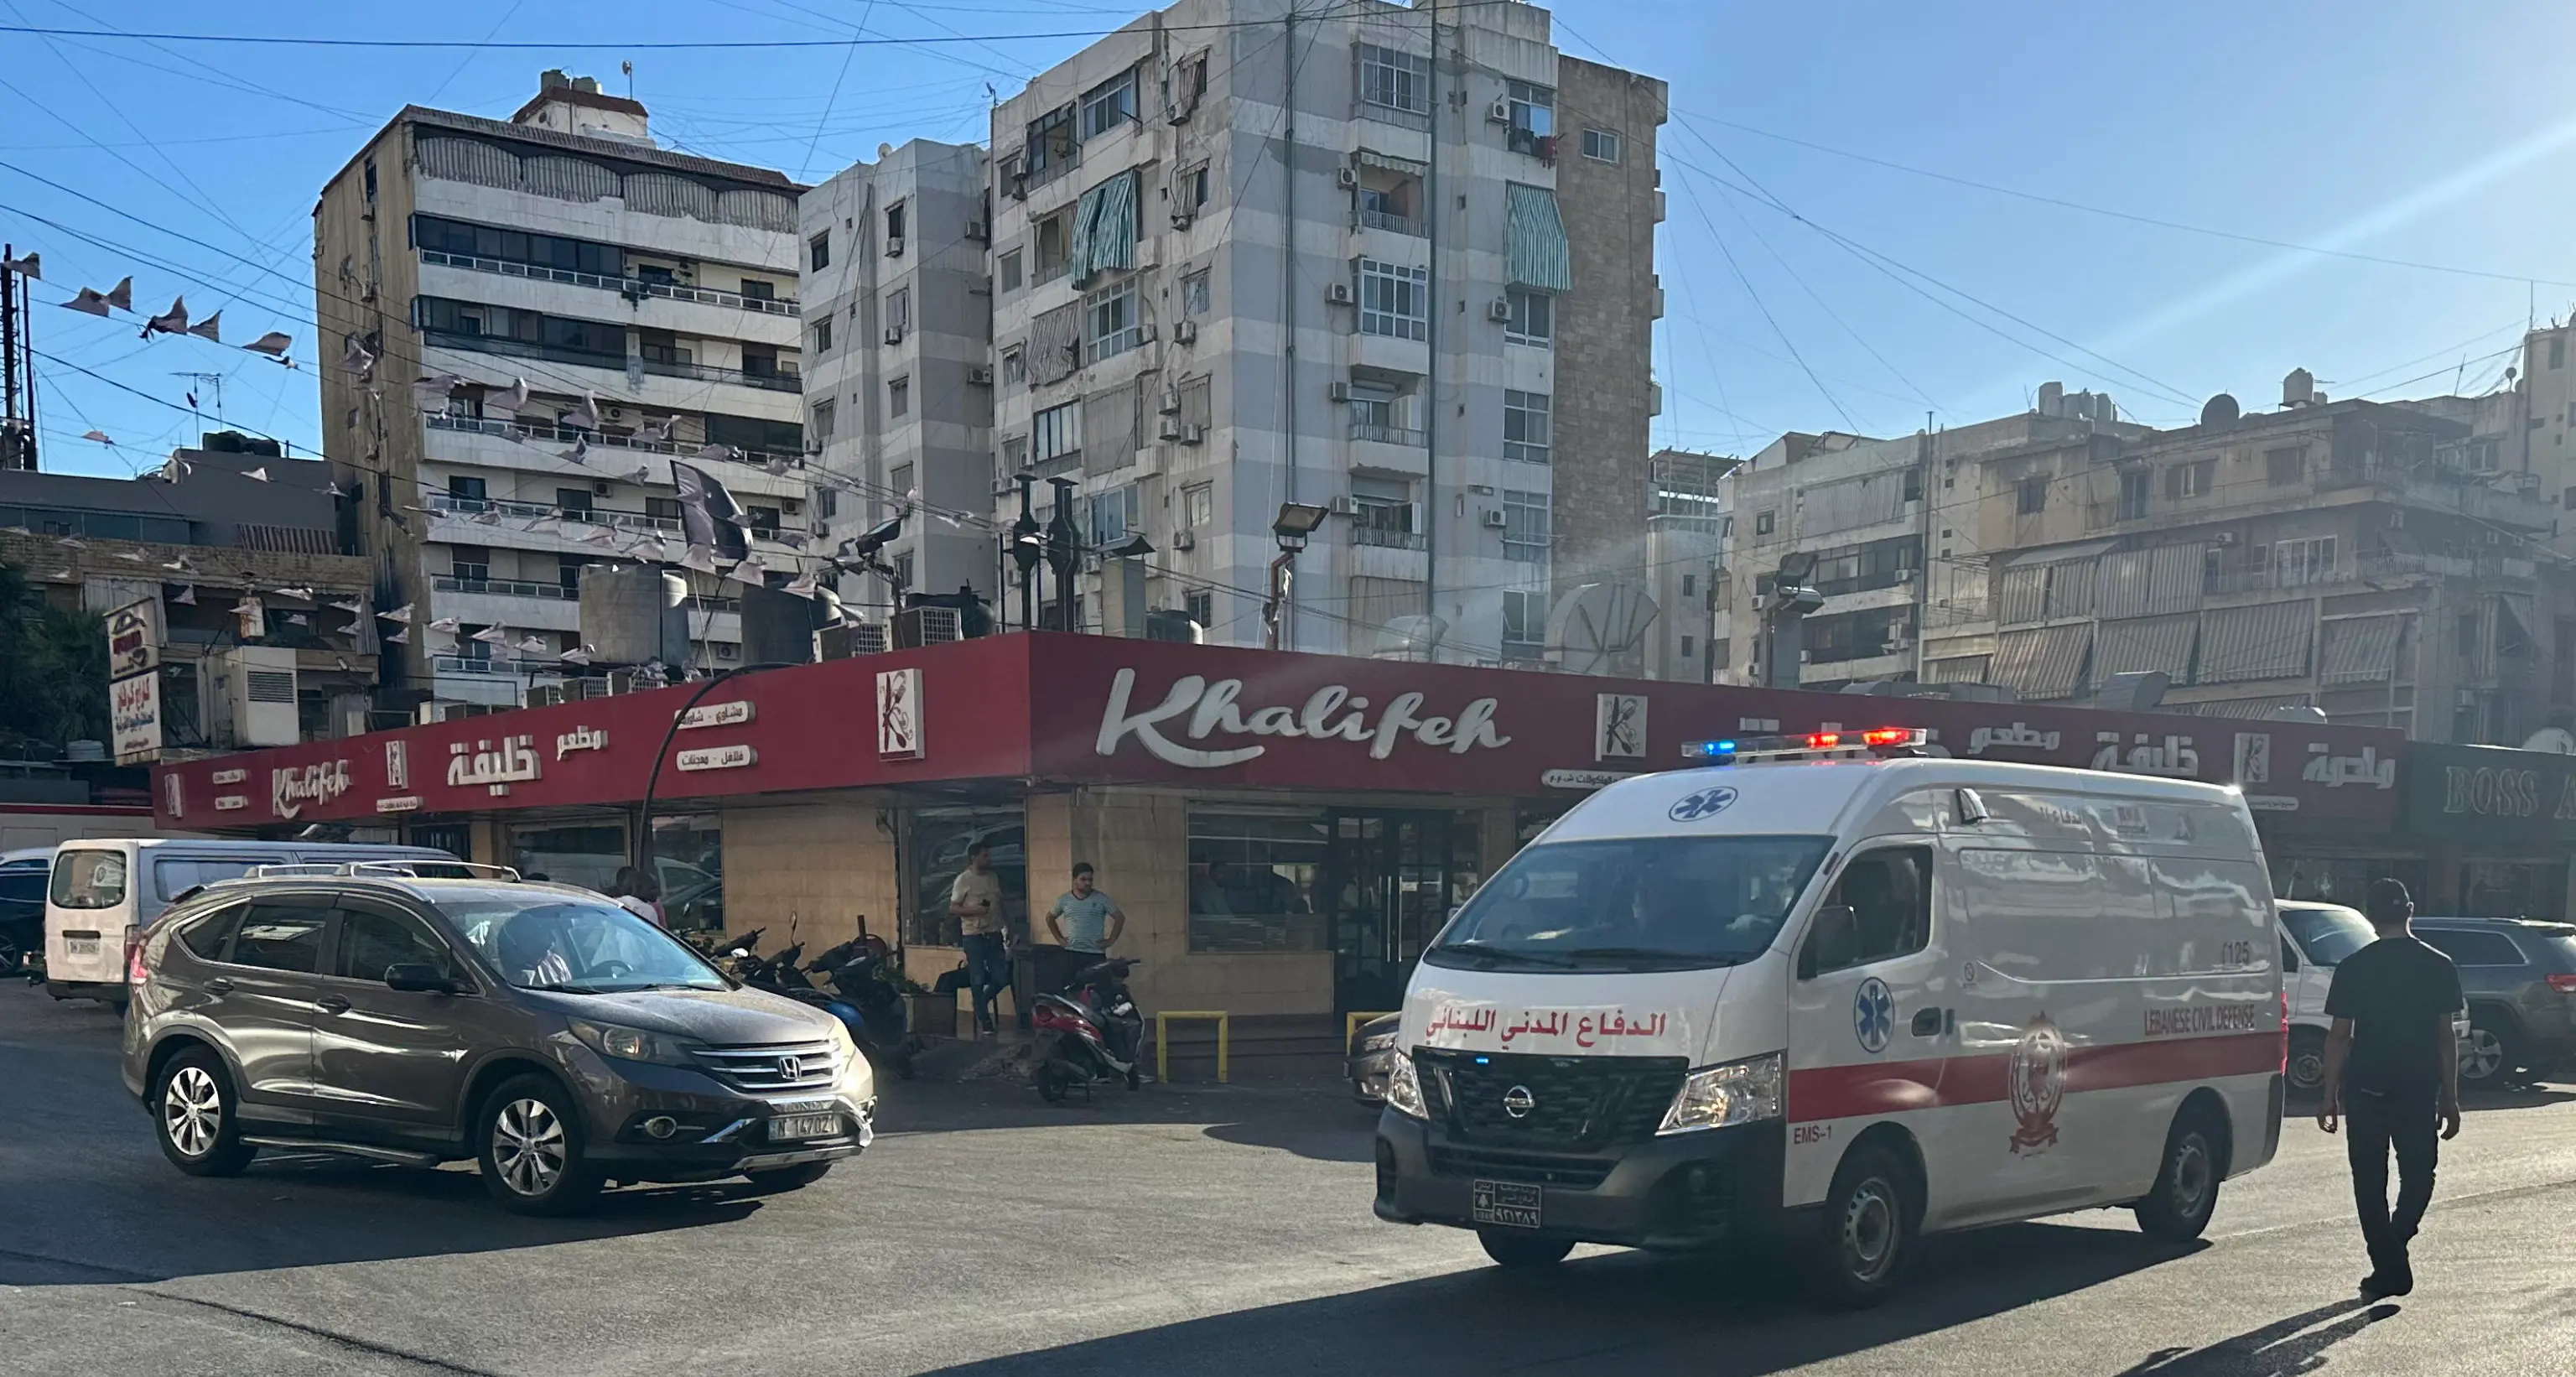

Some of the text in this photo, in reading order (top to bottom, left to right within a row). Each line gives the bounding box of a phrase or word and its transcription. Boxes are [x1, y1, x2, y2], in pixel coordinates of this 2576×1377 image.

[1094, 667, 1511, 768] Khalifeh
[1967, 721, 2060, 755] مطعم
[447, 724, 608, 797] مطعم خليفة
[721, 749, 744, 765] فلافل
[2303, 742, 2396, 789] ملحمة
[273, 759, 352, 819] Khalifeh
[2444, 765, 2541, 818] BOSS
[1426, 1007, 1667, 1050] الدفاع المدني اللبناني
[2144, 1003, 2255, 1037] LEBANESE CIVIL DEFENSE
[1794, 1125, 1832, 1146] EMS-1
